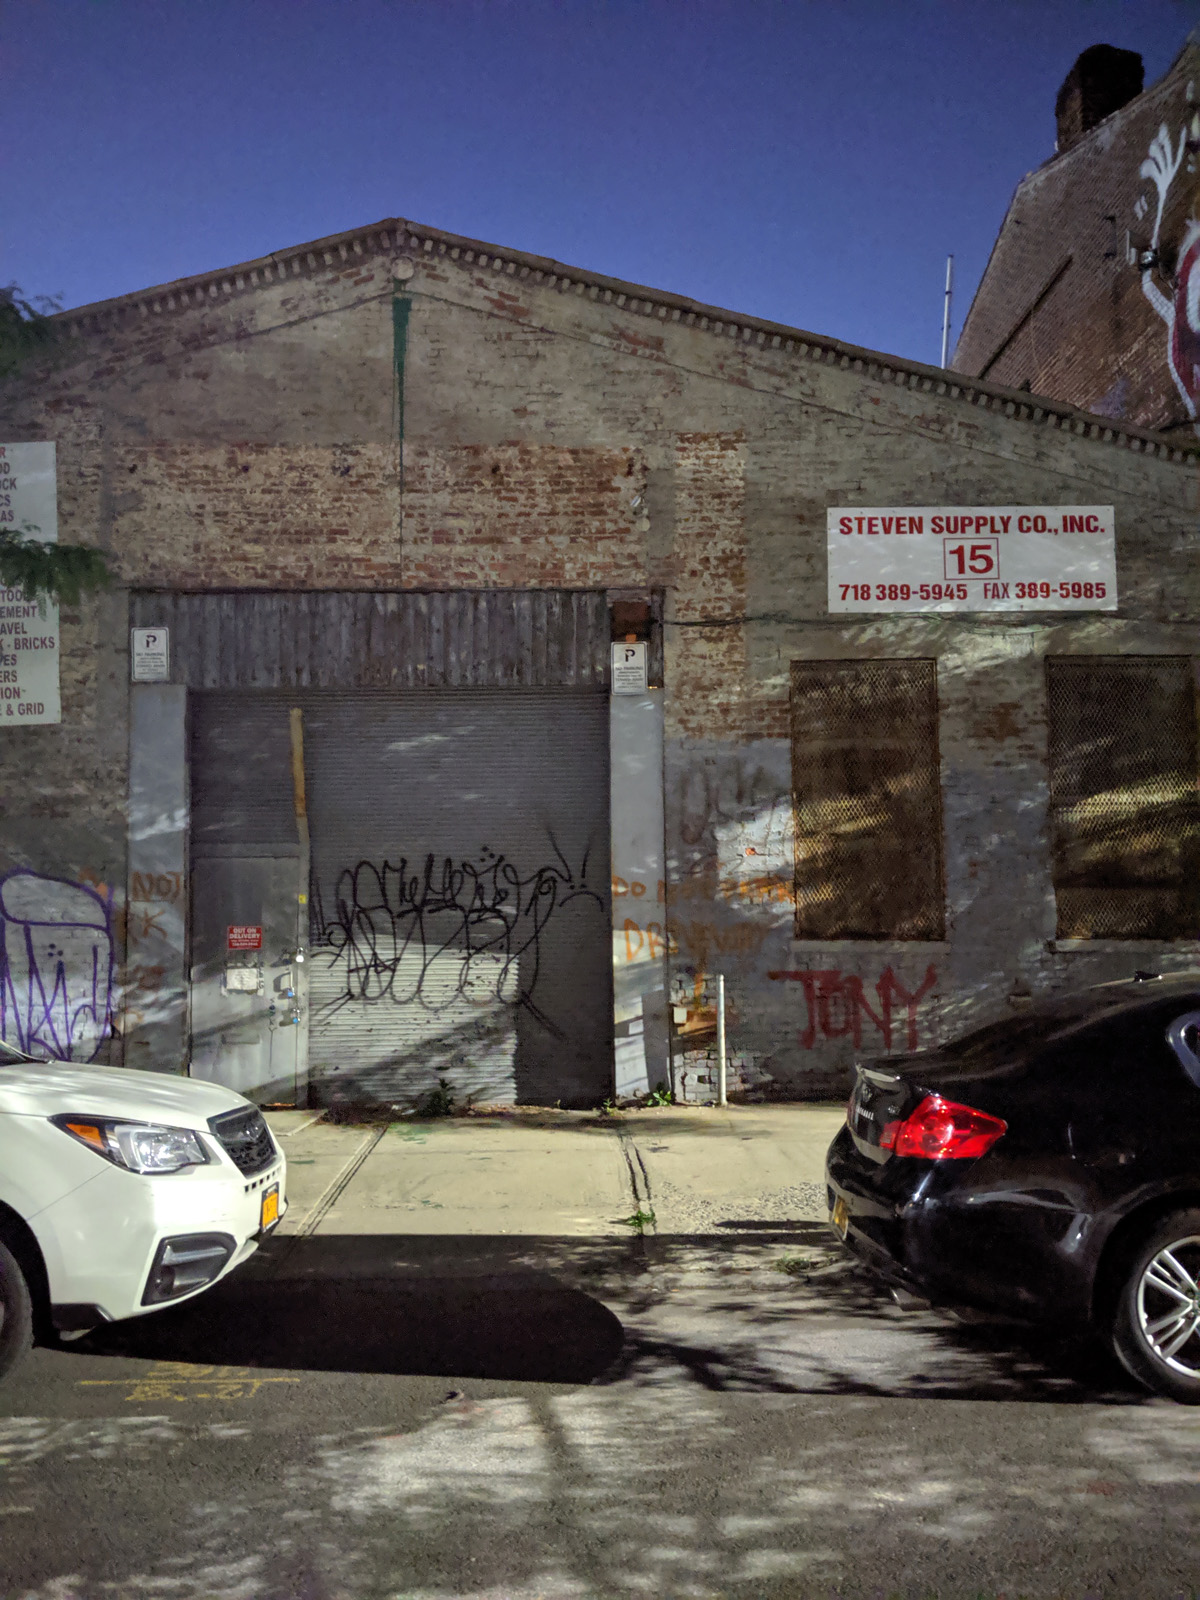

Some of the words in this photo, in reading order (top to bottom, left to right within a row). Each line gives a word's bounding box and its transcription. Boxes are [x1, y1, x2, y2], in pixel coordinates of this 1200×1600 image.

[839, 516, 924, 535] STEVEN
[931, 515, 1012, 534] SUPPLY
[1062, 515, 1106, 533] INC.
[949, 545, 994, 575] 15
[839, 584, 871, 601] 718
[876, 584, 968, 600] 389-5945
[984, 583, 1010, 599] FAX
[1015, 582, 1107, 599] 389-5985
[0, 622, 27, 635] AVEL
[14, 637, 55, 650] BRICKS
[1, 687, 21, 699] ION
[6, 703, 14, 716] &
[18, 703, 44, 716] GRID
